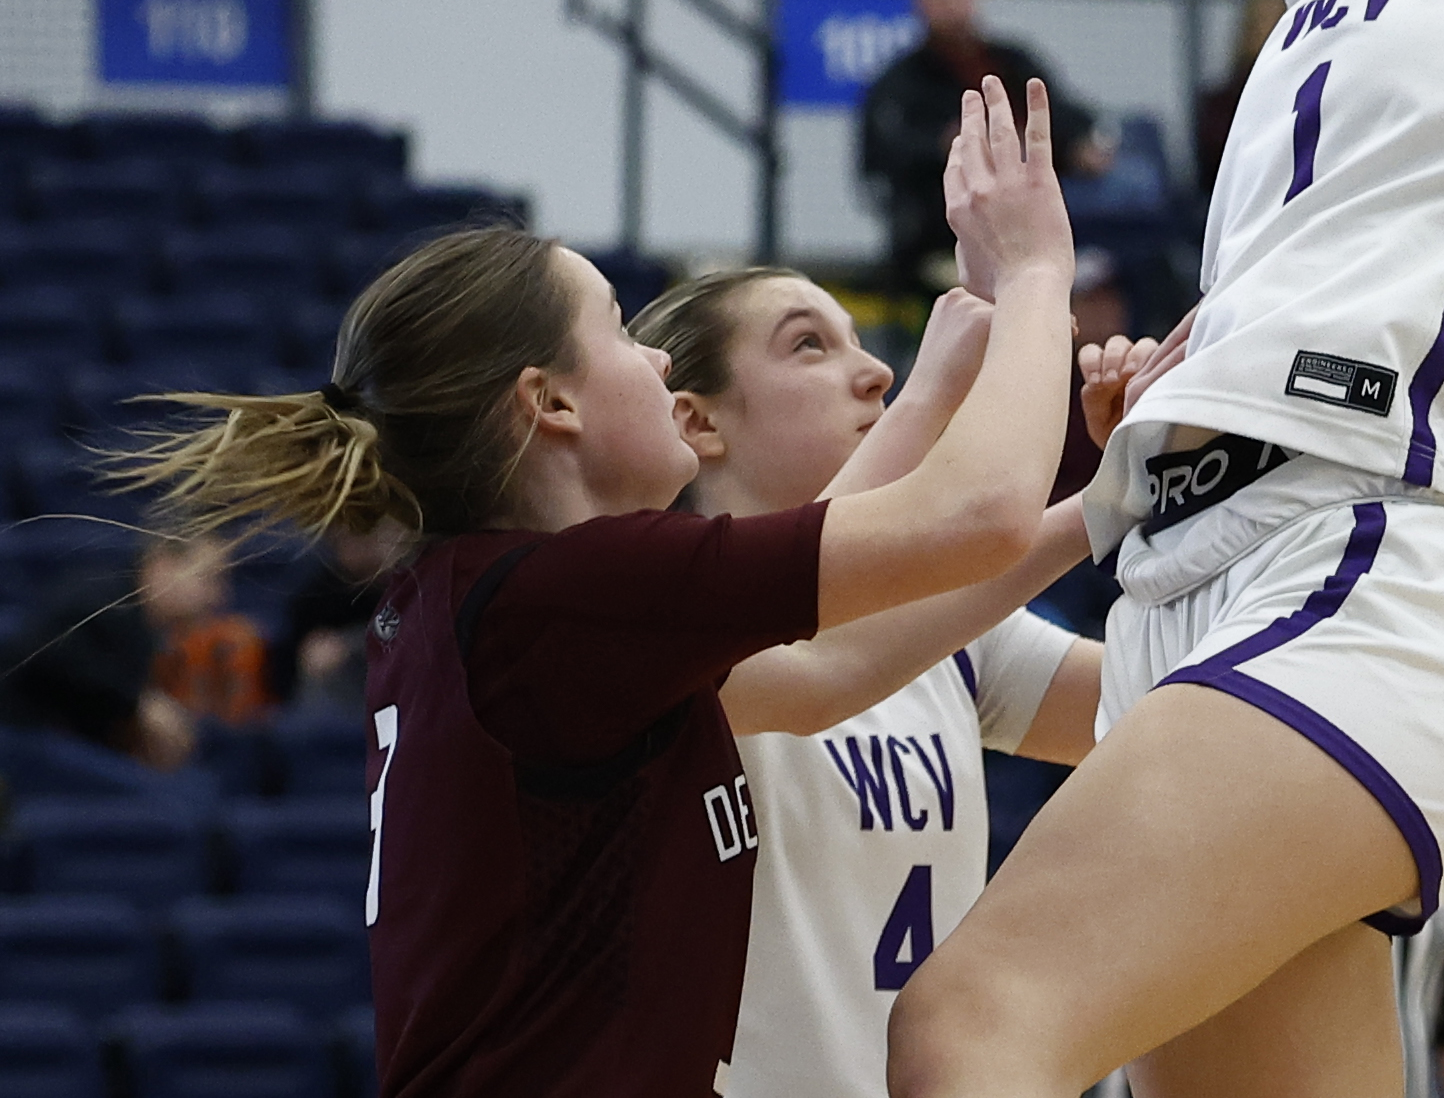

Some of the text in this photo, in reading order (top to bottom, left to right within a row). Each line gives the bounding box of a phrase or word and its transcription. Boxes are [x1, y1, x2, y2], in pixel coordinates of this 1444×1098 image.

[1282, 59, 1333, 207] 1
[1360, 378, 1381, 400] M
[823, 733, 954, 832] WCV
[873, 864, 934, 991] 4
